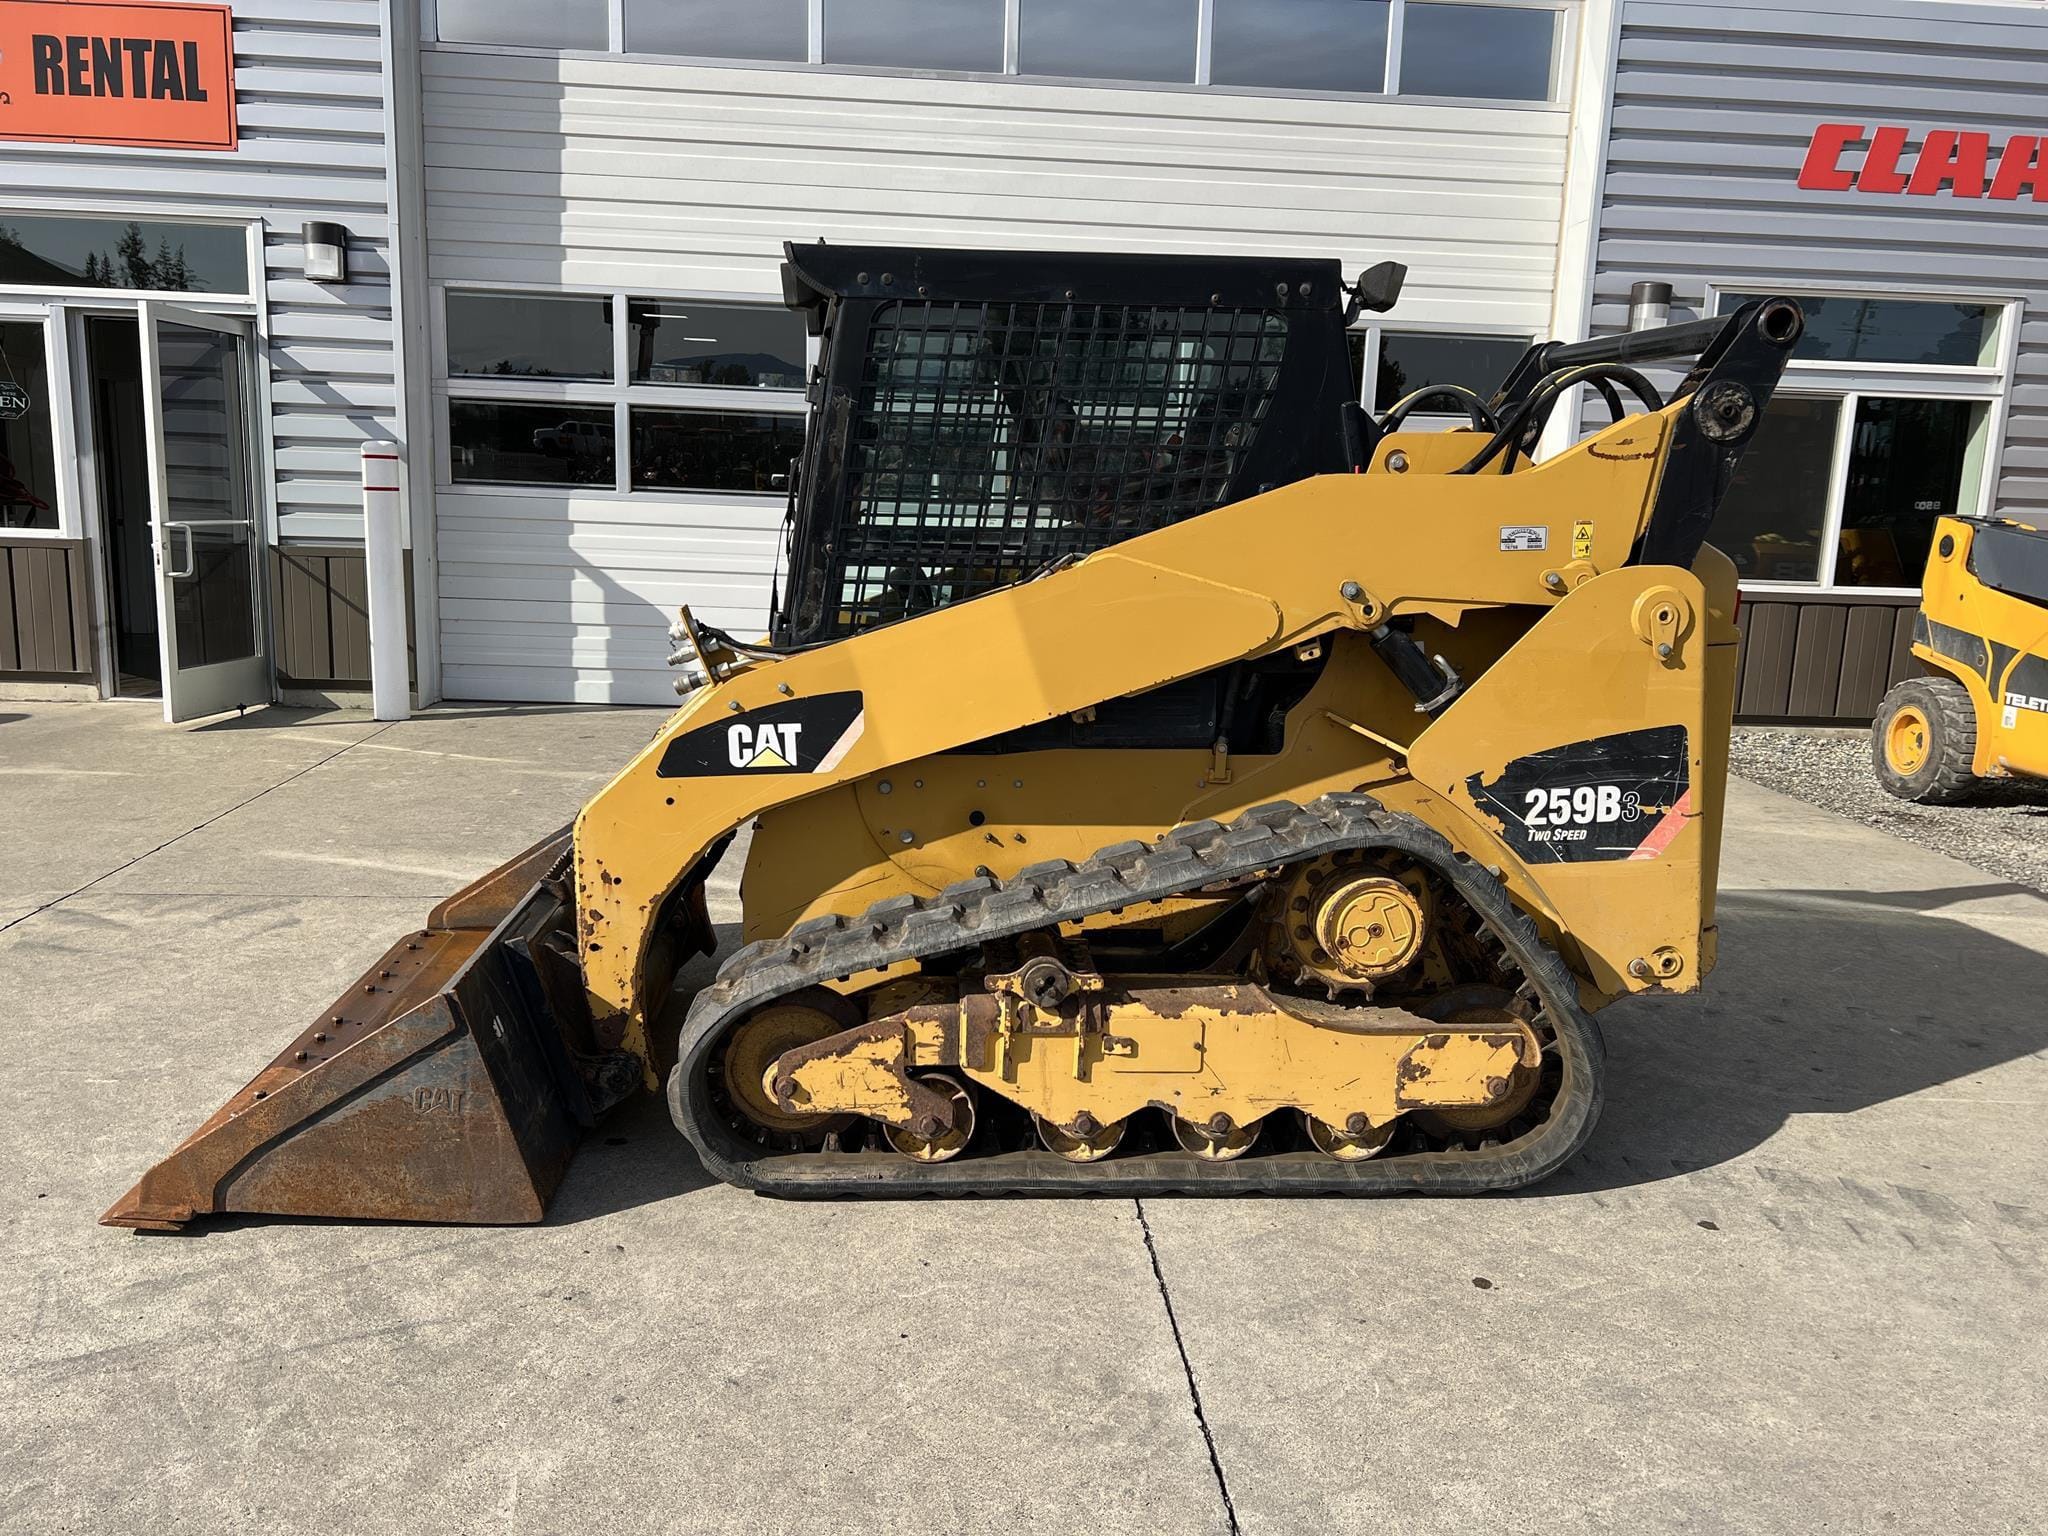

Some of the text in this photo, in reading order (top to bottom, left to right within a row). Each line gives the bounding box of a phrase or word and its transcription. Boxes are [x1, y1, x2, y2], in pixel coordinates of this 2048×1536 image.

[32, 34, 208, 102] RENTAL
[2004, 692, 2048, 713] TELET
[727, 723, 802, 768] CAT
[1527, 828, 1587, 842] TWO SPEED
[413, 1086, 464, 1115] CAT
